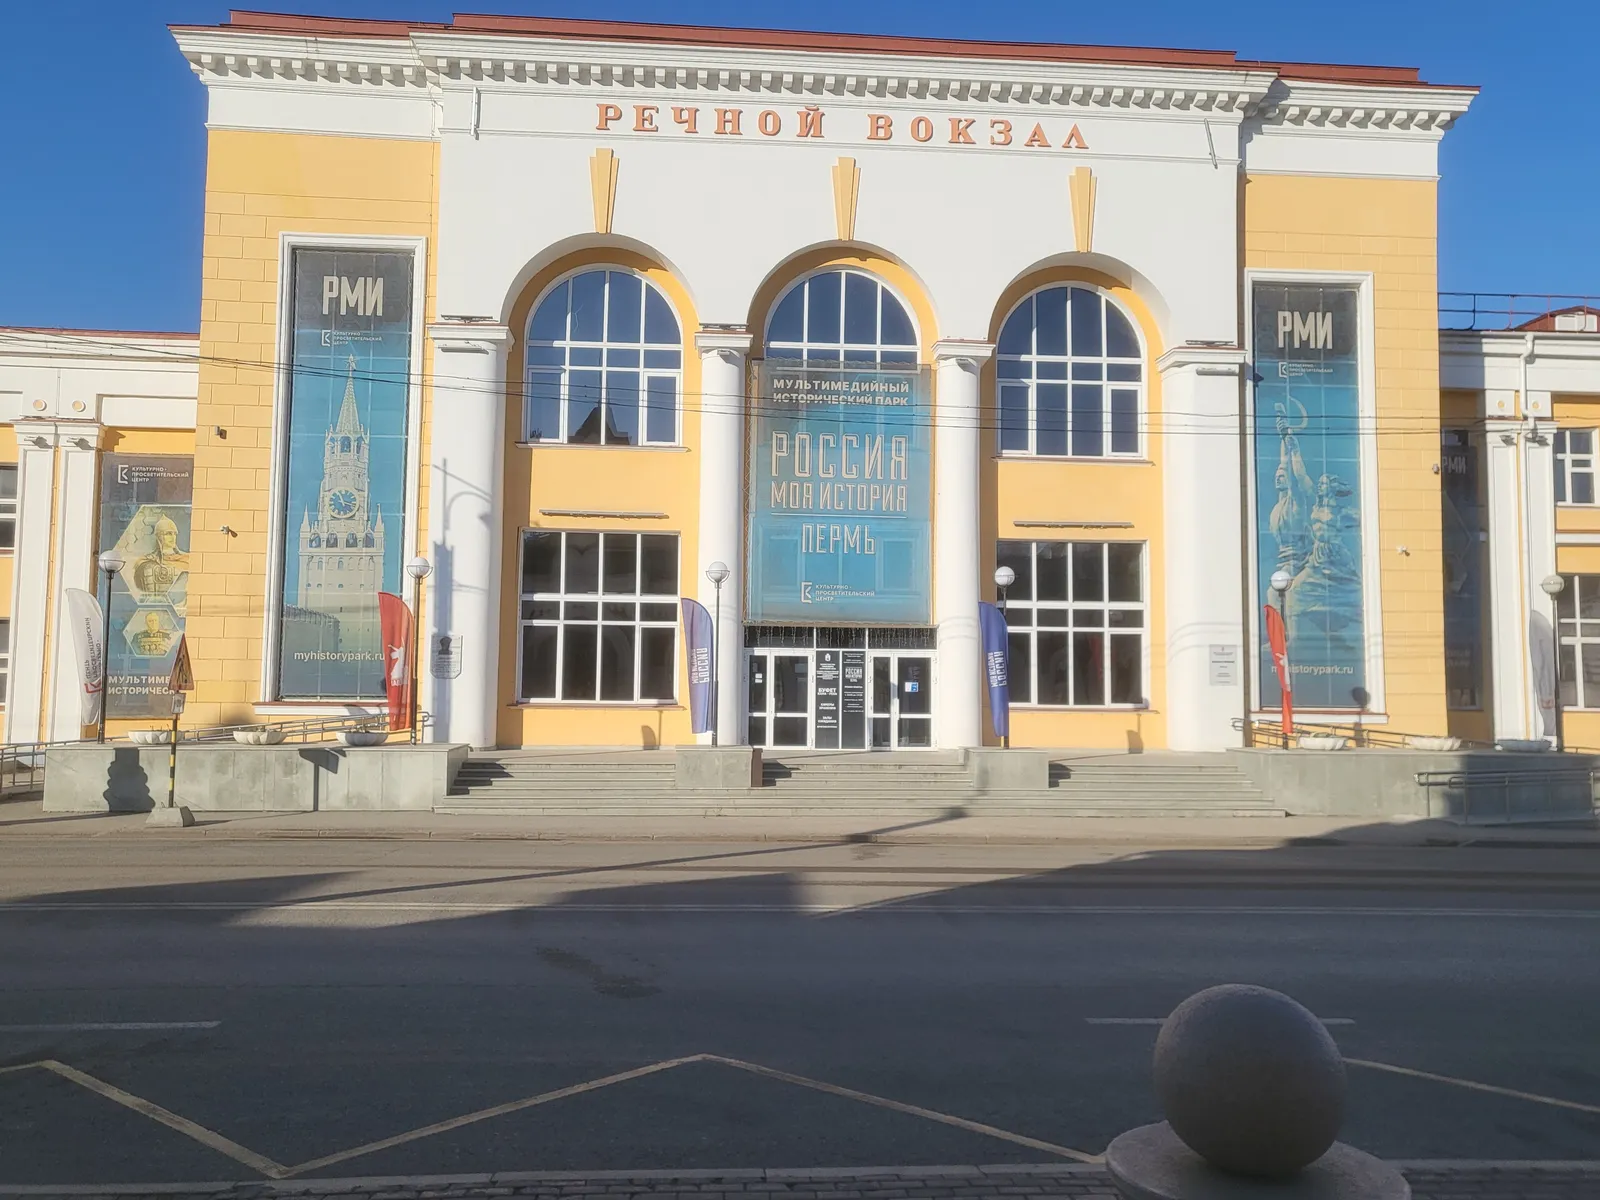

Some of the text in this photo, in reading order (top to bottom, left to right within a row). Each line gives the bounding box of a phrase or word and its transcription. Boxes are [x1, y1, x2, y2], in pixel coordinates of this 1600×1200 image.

[596, 103, 1090, 149] РЕЧНОЙ ВОКЗАЛ
[322, 275, 384, 316] РМИ
[1277, 310, 1333, 350] РМИ
[773, 378, 909, 393] МУЛЬТИМЕДИЙНЫЙ
[773, 392, 909, 406] ИСТОРИЧЕСКИЙ ПАРК
[771, 431, 909, 480] РОССИЯ
[771, 480, 908, 512] МОЯ ИСТОРИЯ
[802, 523, 876, 555] ПЕРМЬ
[294, 650, 385, 663] myhistorypark.ru
